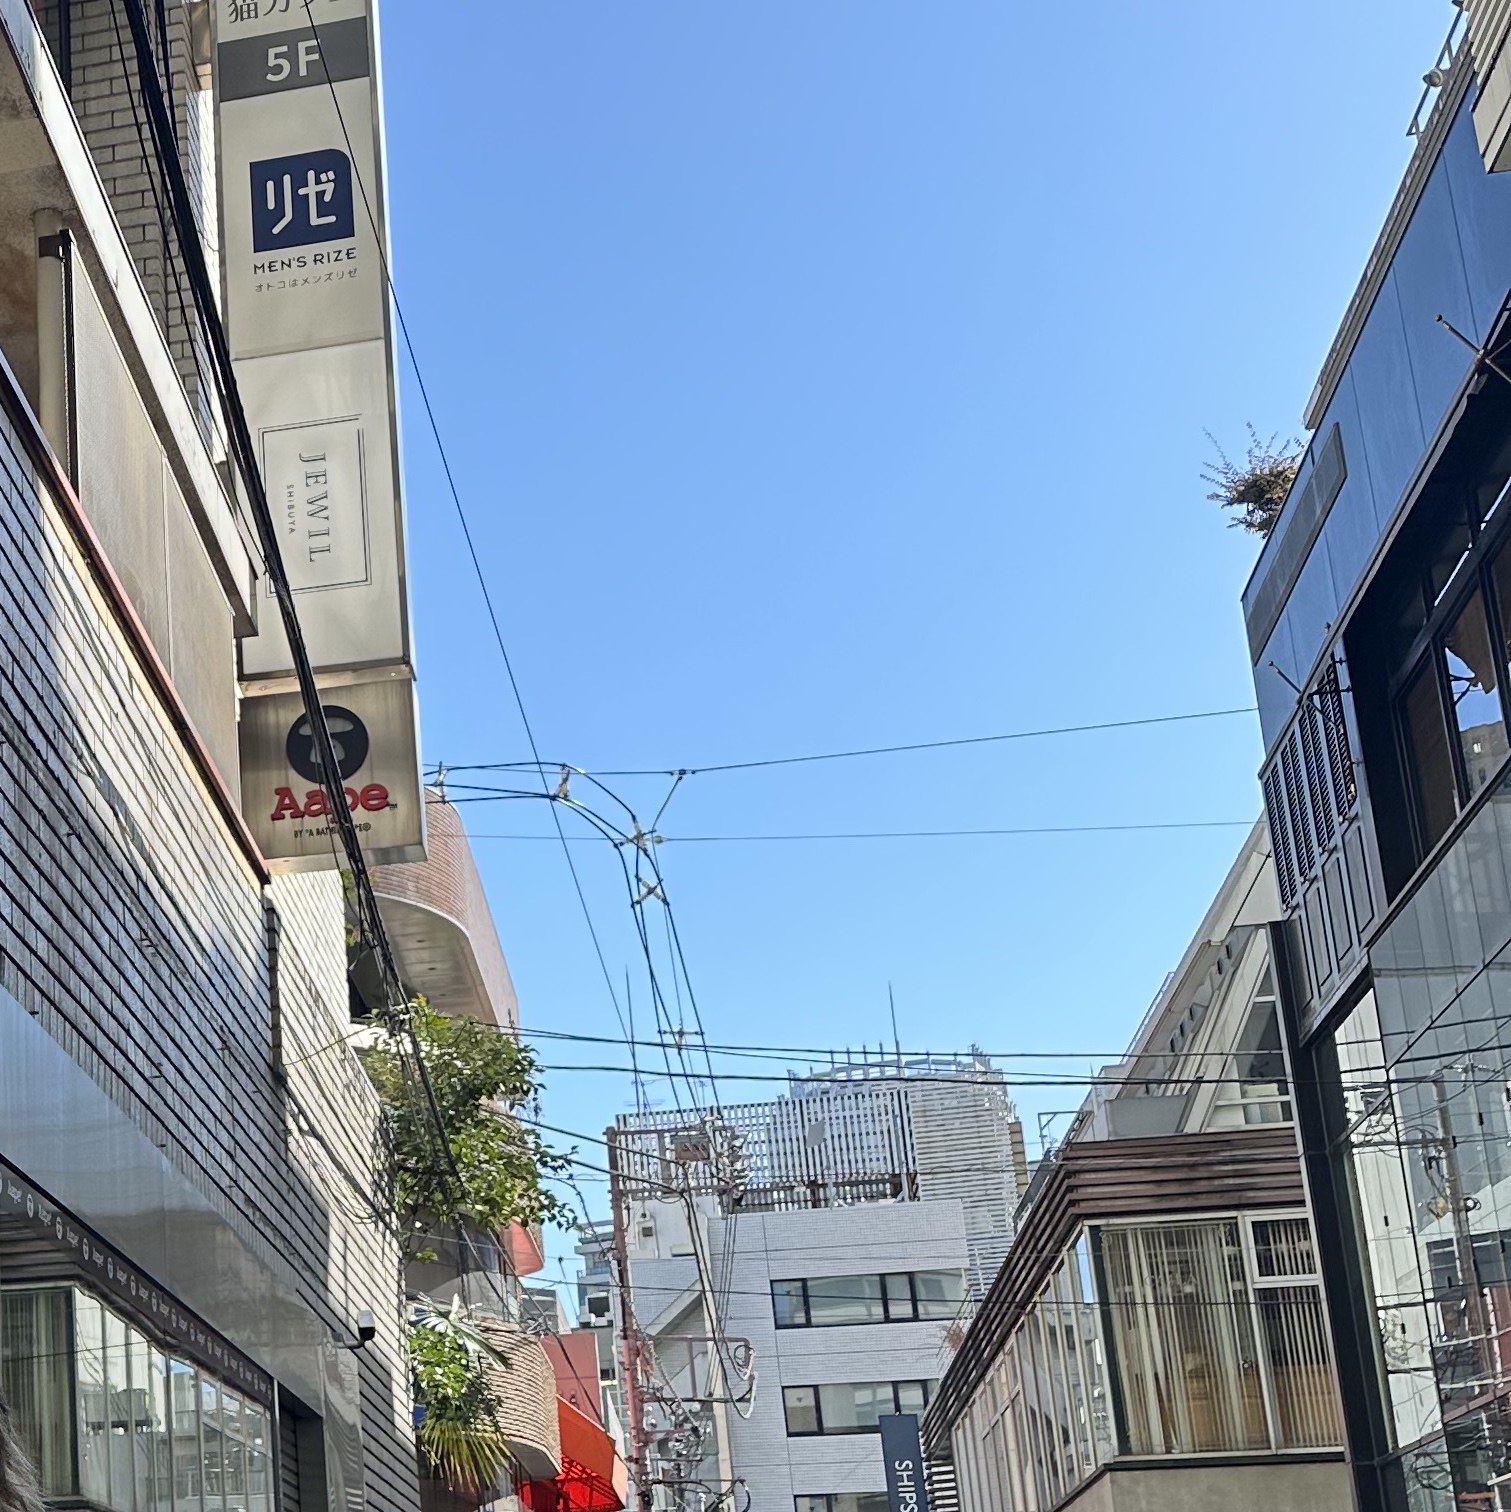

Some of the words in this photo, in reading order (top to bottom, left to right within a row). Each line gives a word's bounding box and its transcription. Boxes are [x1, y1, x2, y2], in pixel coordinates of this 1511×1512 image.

[266, 38, 320, 82] 5F
[266, 170, 336, 234] リゼ
[253, 256, 307, 275] MEN'S
[313, 247, 357, 265] RIZE
[287, 484, 296, 534] SHIBUYA
[299, 452, 331, 562] JEWIL
